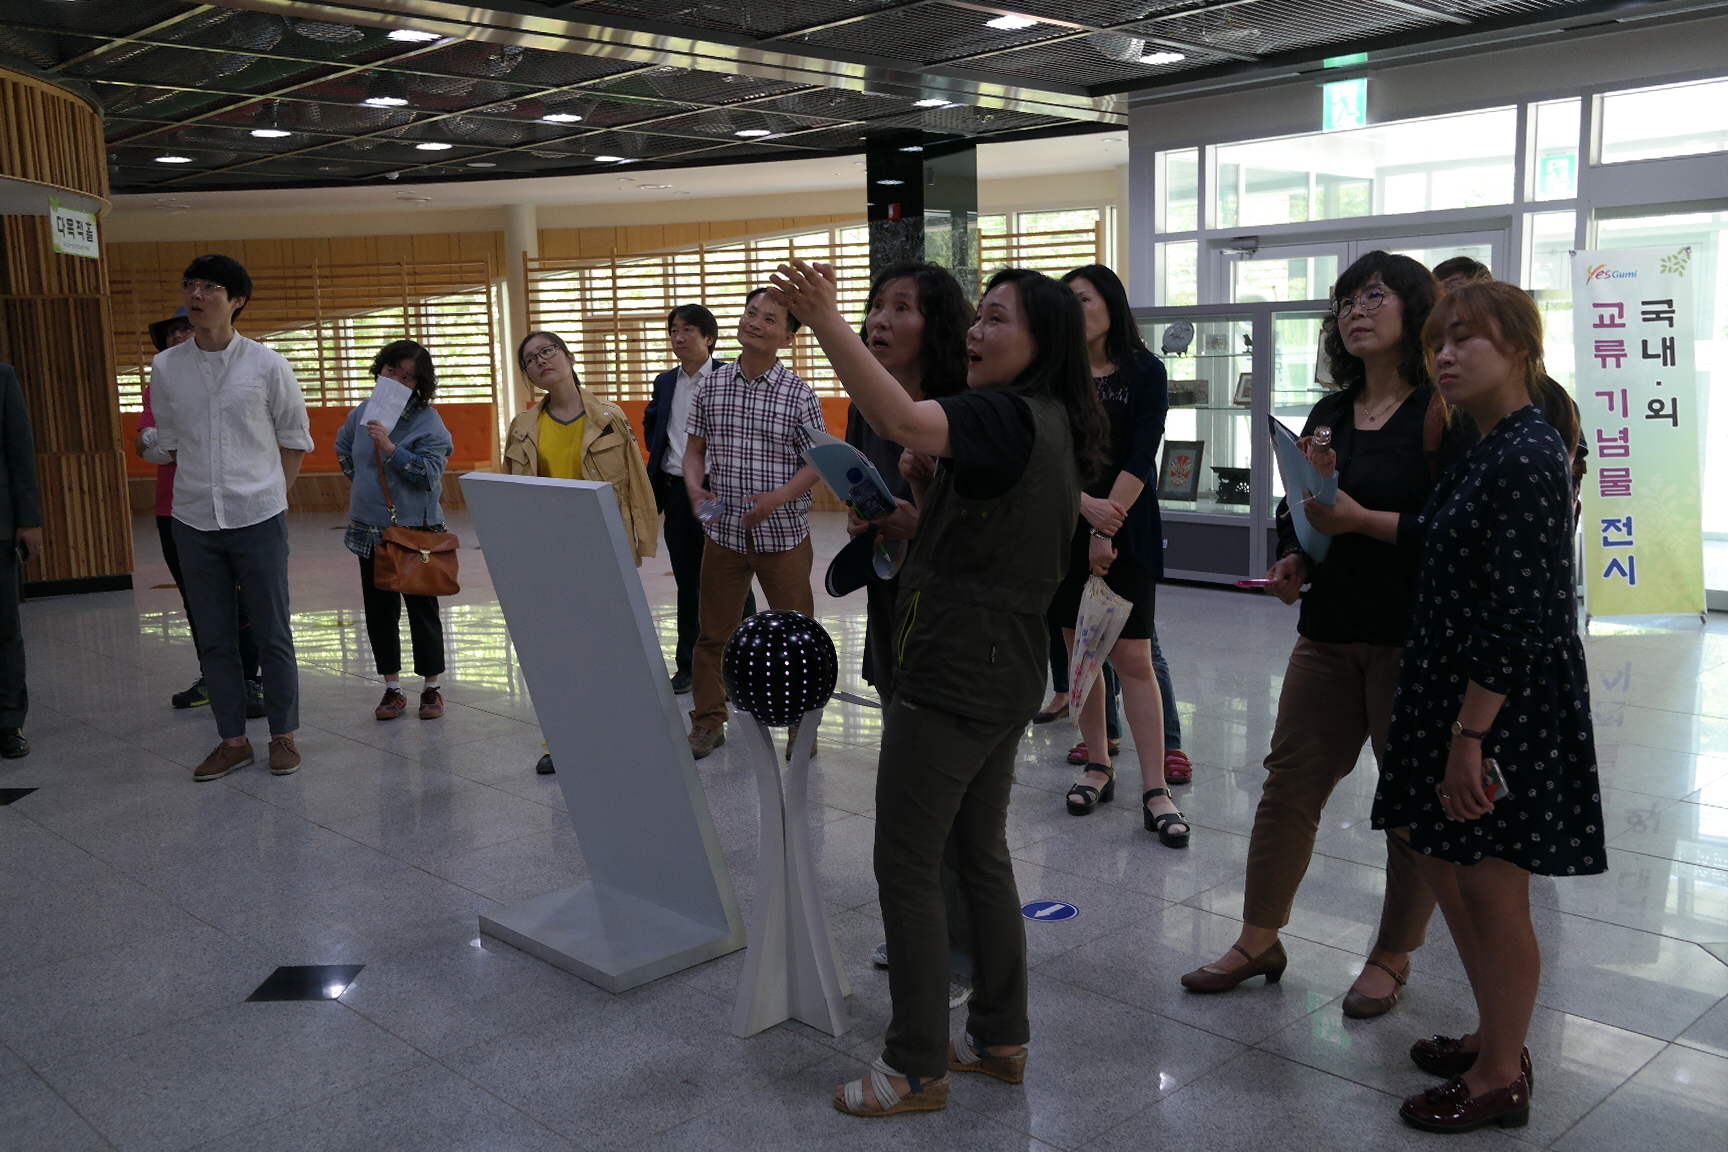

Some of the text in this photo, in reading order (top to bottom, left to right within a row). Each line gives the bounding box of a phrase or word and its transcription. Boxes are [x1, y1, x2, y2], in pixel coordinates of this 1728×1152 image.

[1592, 302, 1635, 585] 교류 기념물 전시
